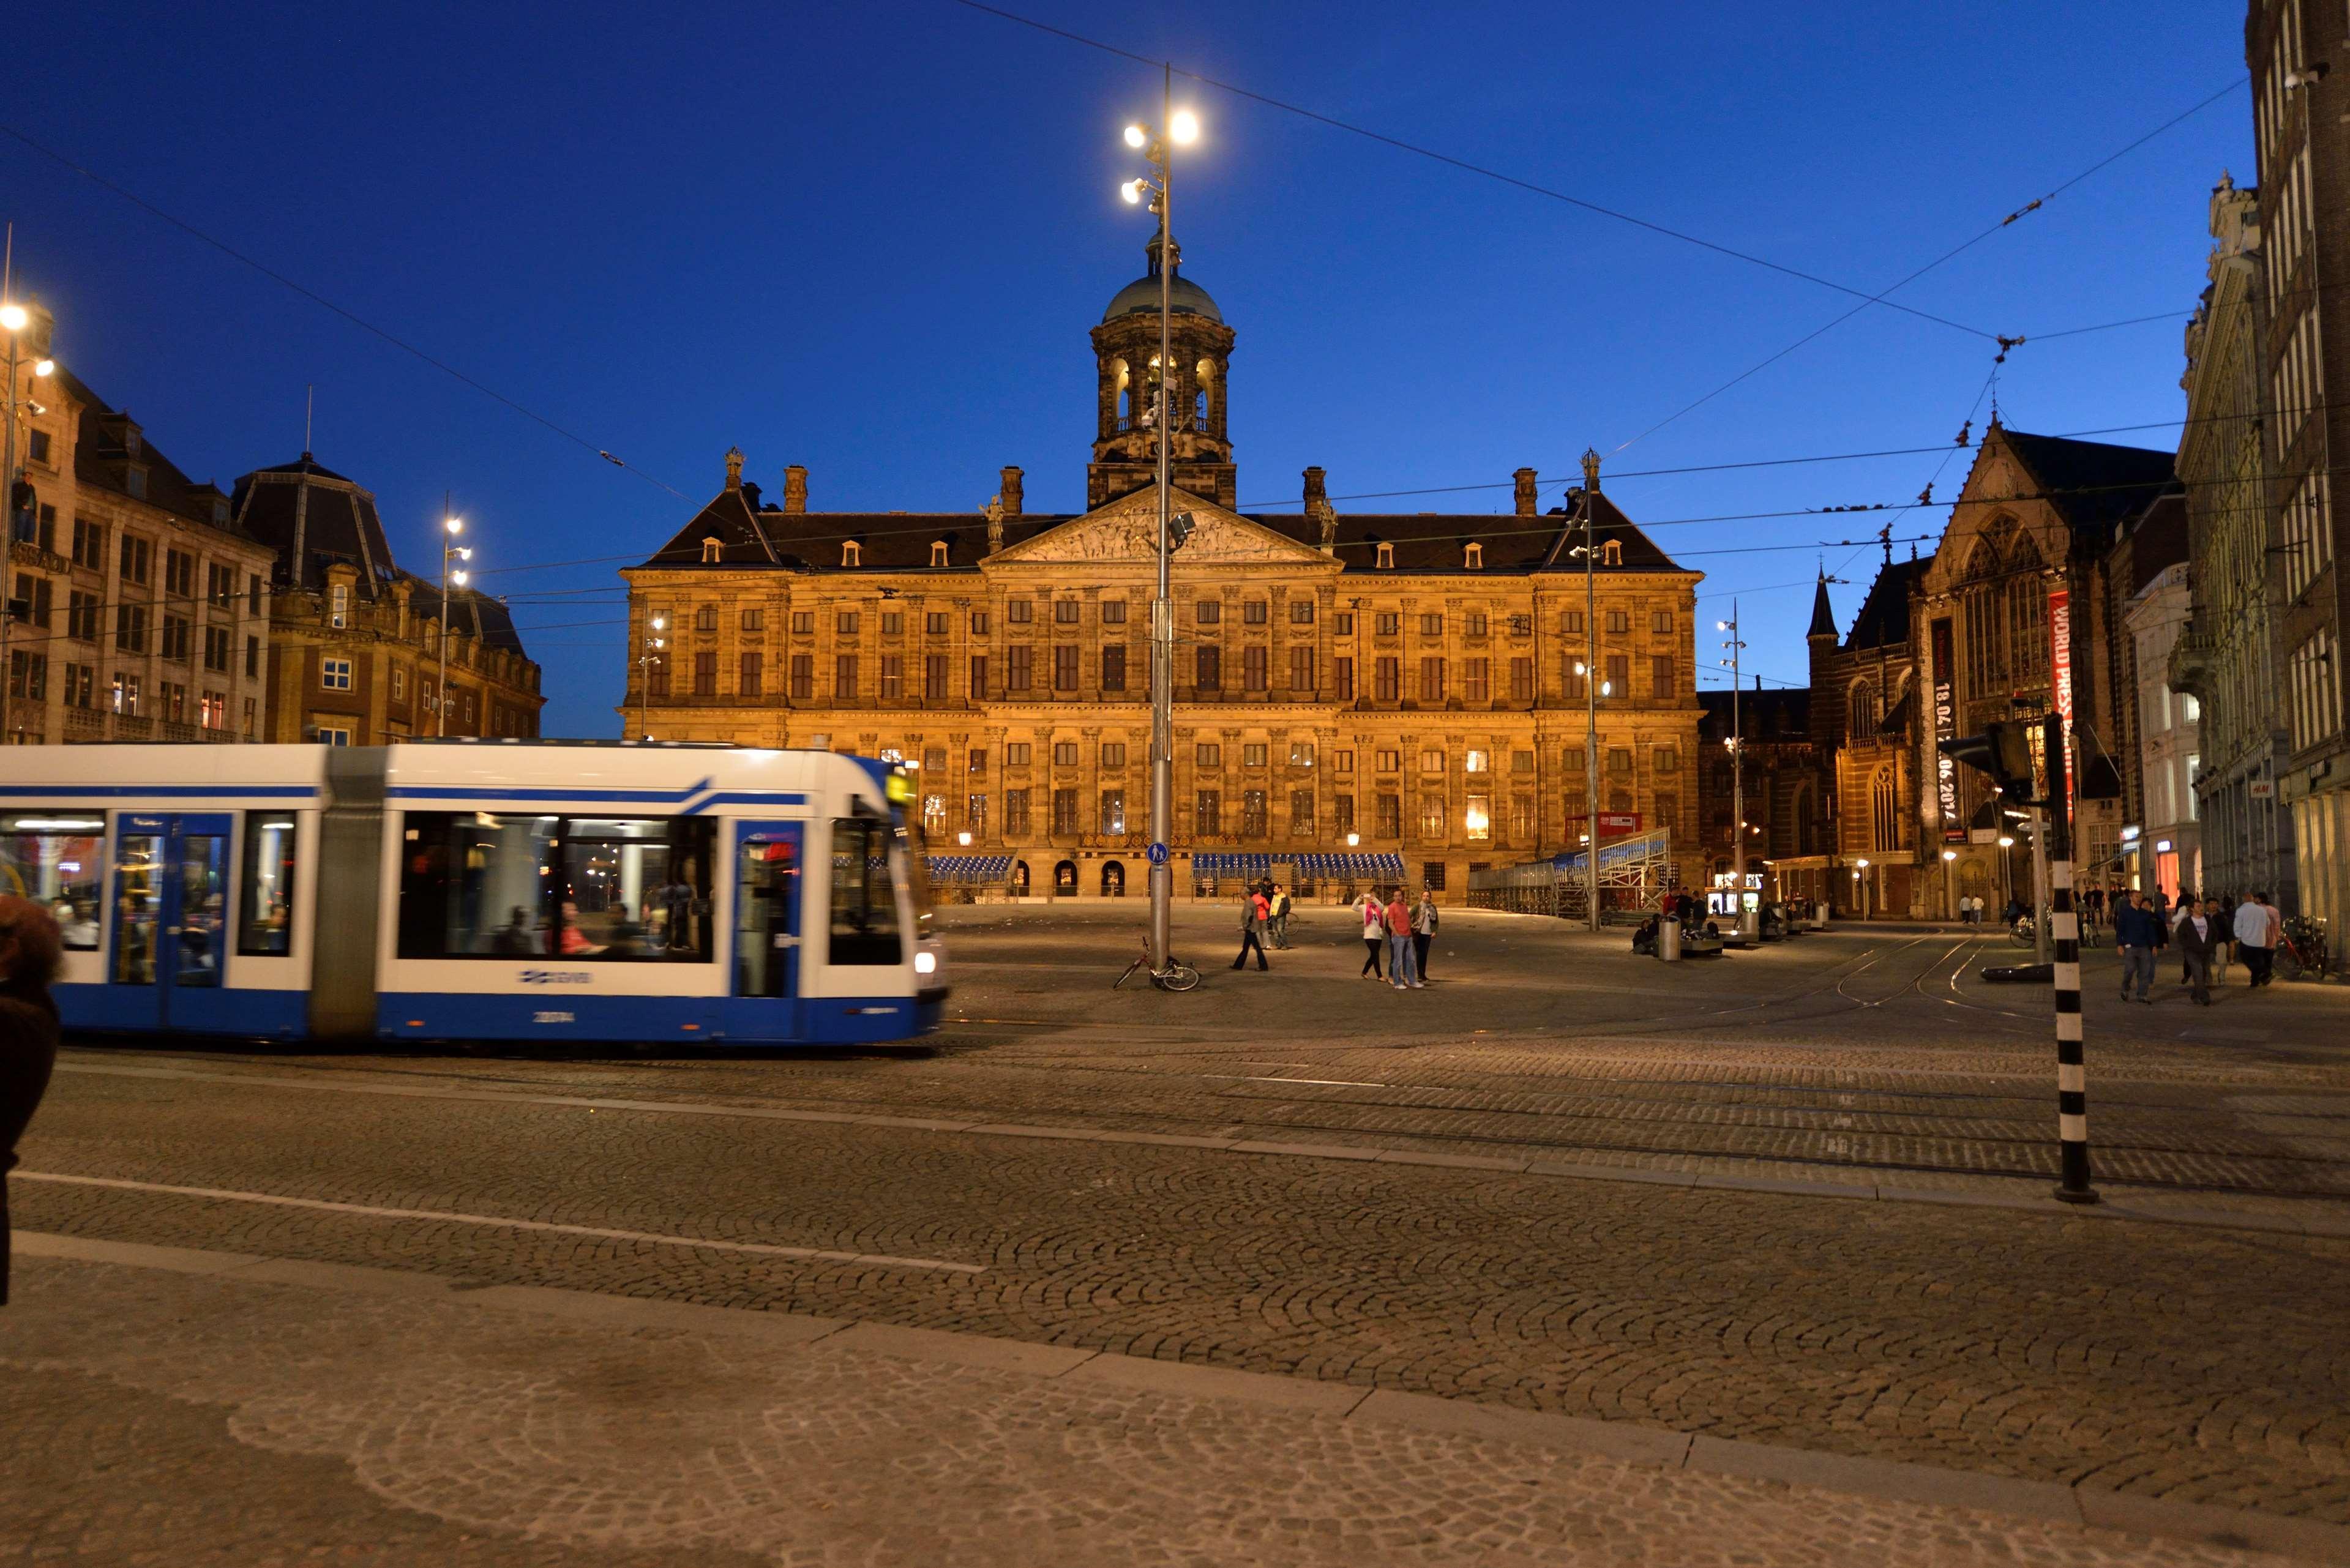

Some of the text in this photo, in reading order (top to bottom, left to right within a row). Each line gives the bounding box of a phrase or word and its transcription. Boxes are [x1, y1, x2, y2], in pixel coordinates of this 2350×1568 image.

[2054, 606, 2070, 663] WORLD
[1936, 682, 1951, 725] 18.04
[2056, 667, 2072, 717] PRESS
